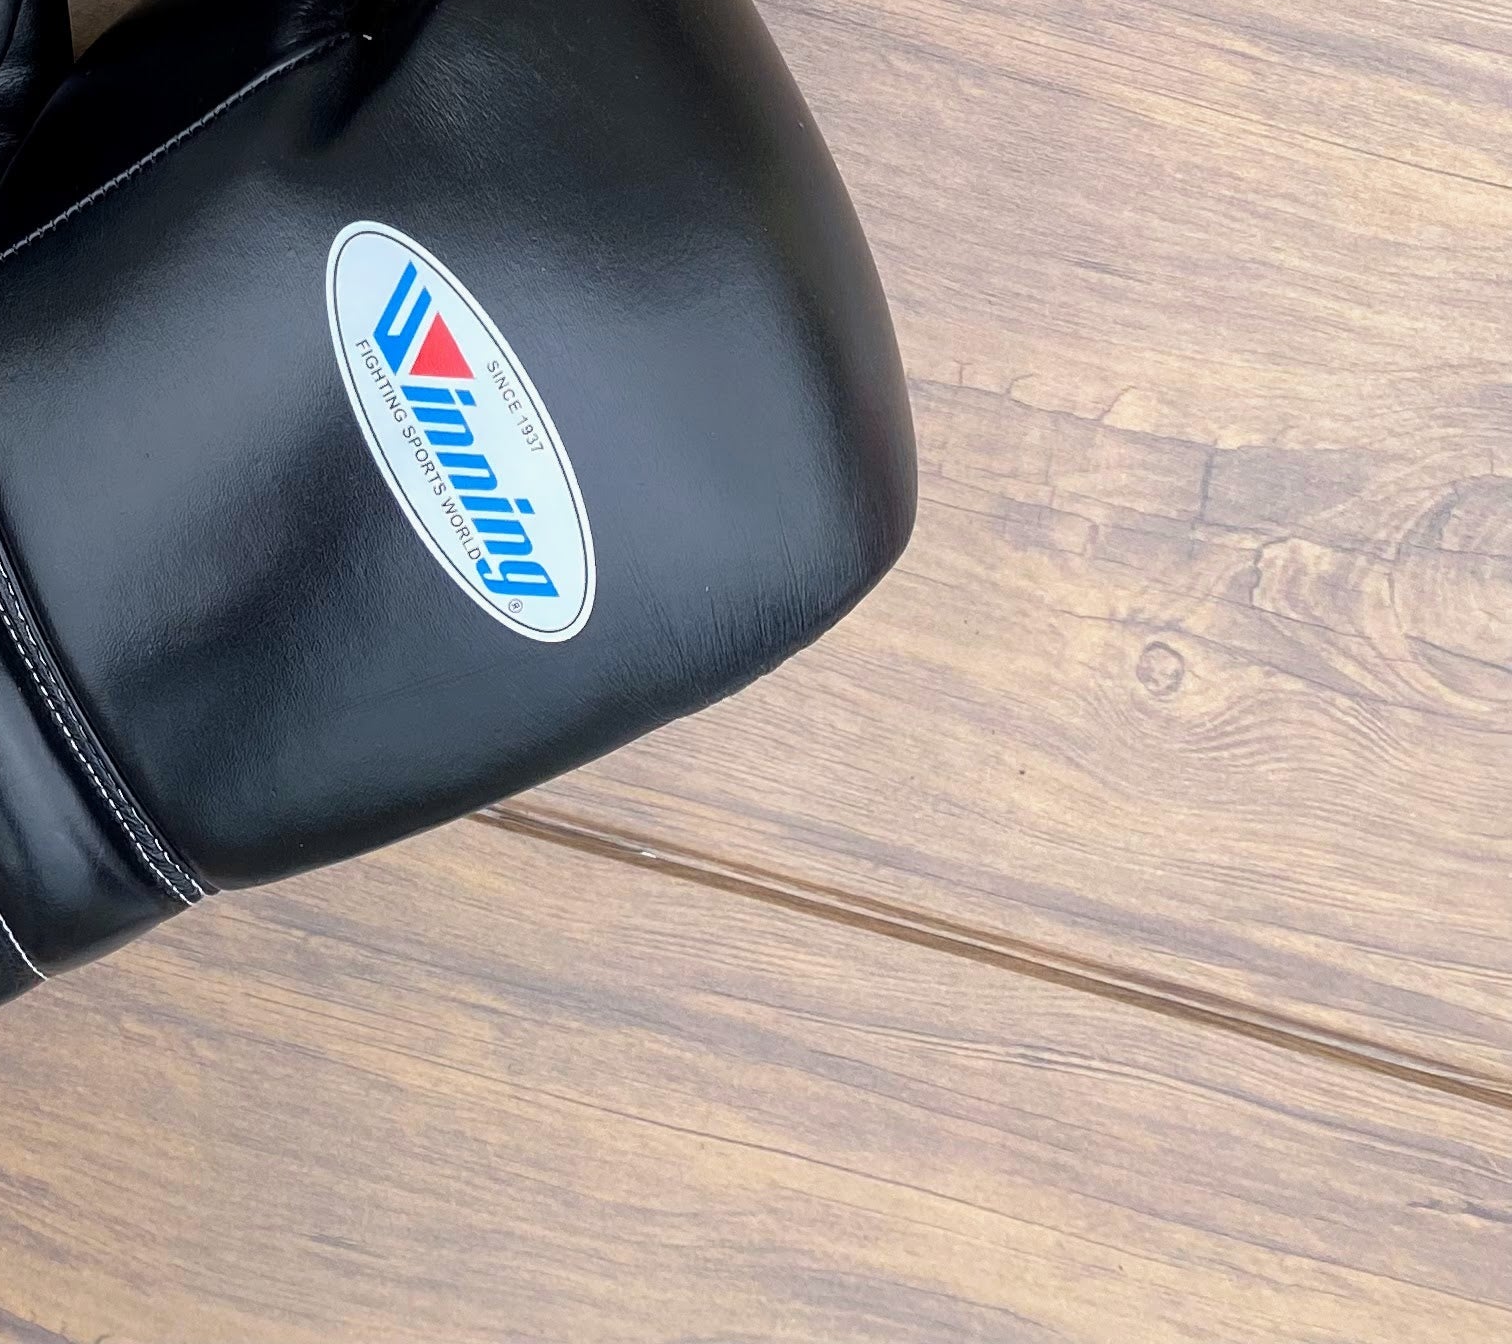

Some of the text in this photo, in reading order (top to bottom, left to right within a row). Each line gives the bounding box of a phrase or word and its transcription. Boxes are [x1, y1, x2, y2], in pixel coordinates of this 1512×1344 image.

[354, 338, 482, 562] FIGHTING SPORTS WORLD
[486, 360, 545, 454] SINCE 1937
